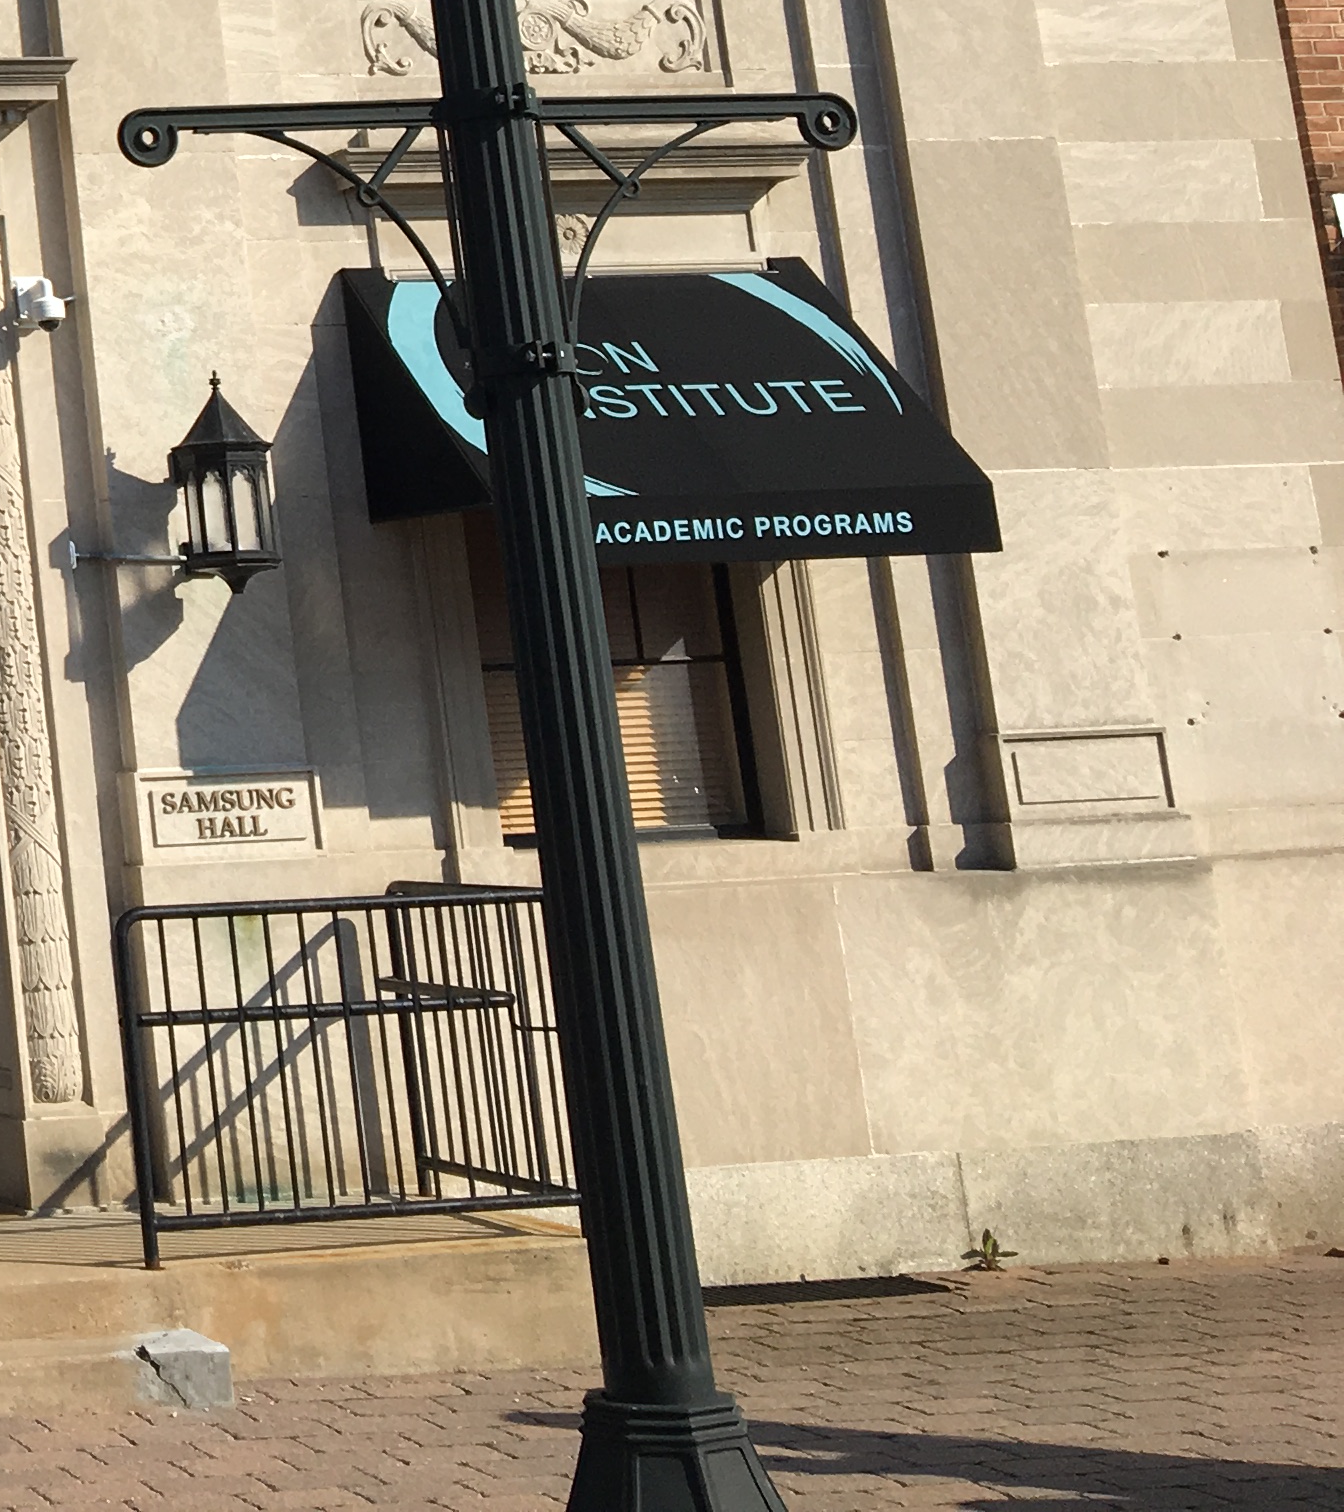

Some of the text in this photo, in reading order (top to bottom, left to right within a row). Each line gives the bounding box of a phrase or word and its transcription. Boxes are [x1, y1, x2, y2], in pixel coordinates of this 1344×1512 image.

[575, 341, 660, 376] ON
[582, 379, 867, 420] STITUTE
[594, 510, 914, 545] ACADEMIC PROGRAMS
[161, 787, 296, 815] SAMSUNG
[195, 814, 269, 840] HALL
